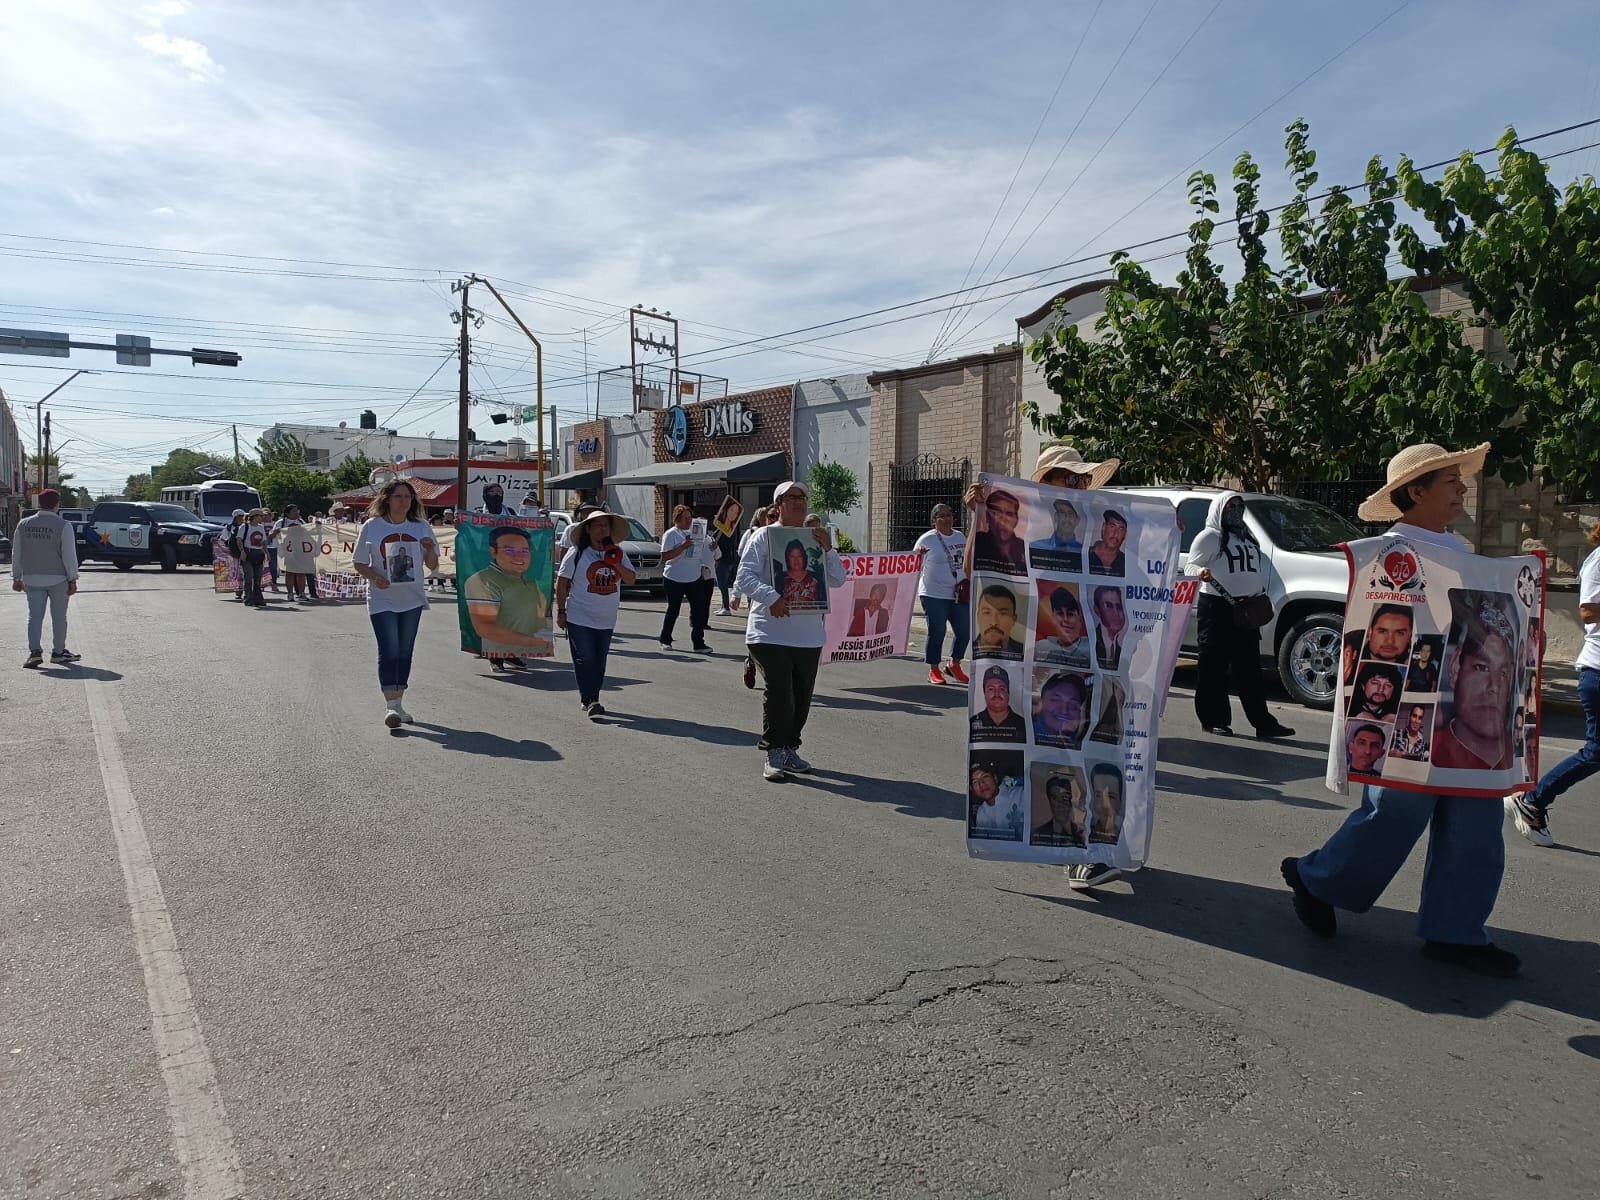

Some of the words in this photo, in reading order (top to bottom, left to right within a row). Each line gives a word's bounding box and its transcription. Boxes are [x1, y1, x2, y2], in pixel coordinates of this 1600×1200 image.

[496, 474, 530, 490] Pizz
[286, 540, 355, 555] ¿DÓN
[855, 556, 874, 576] SE
[878, 554, 922, 575] BUSCA
[1147, 559, 1167, 575] LOS
[838, 638, 865, 650] JESÚS
[865, 635, 891, 649] ALBERTO
[830, 651, 868, 662] MORALES
